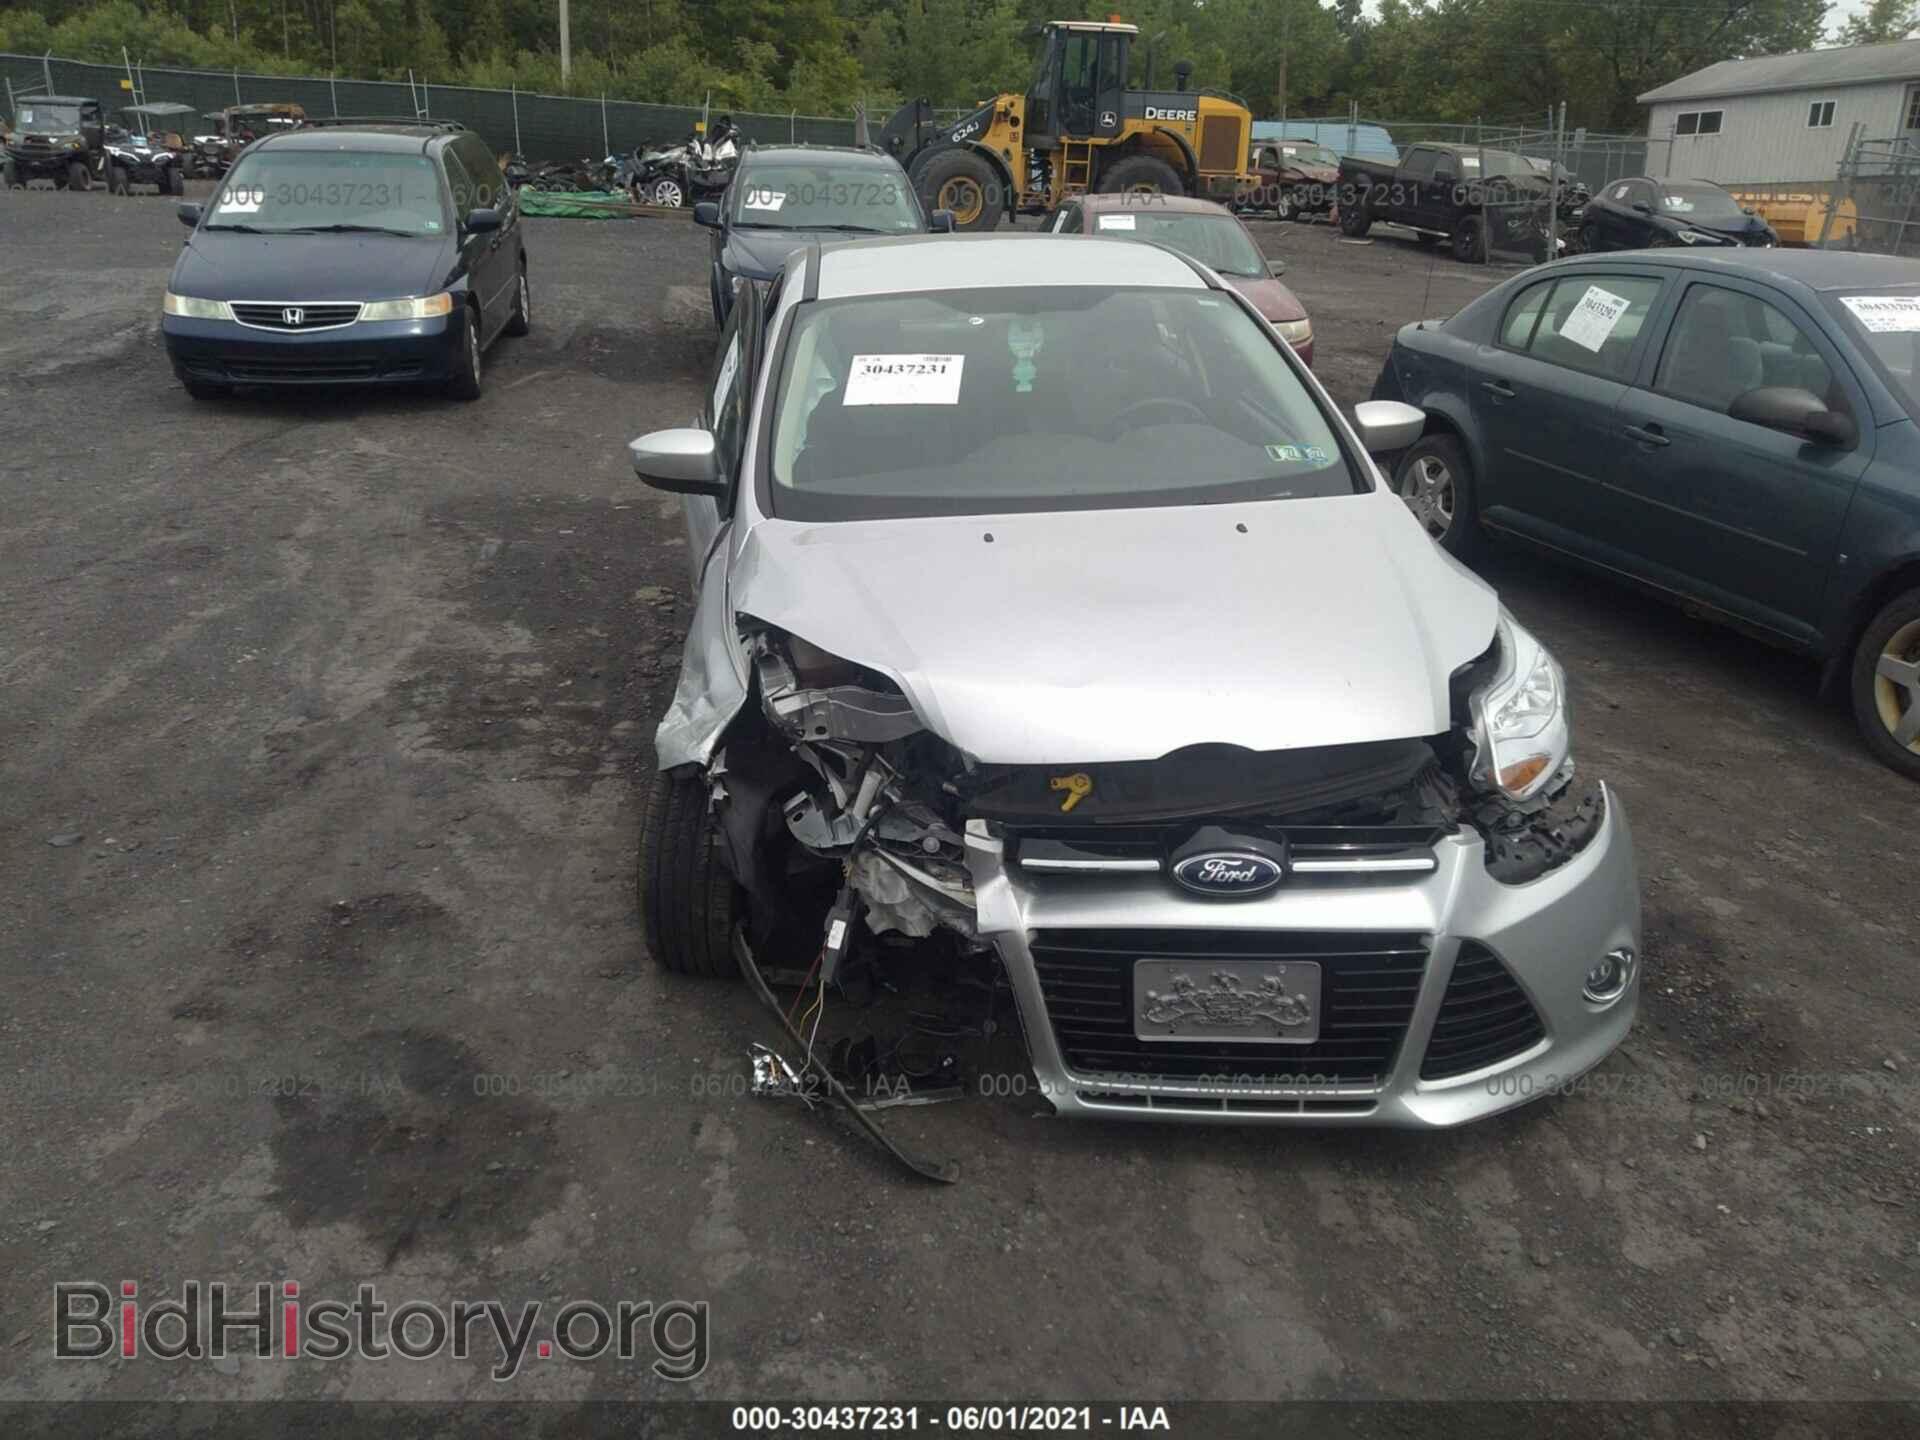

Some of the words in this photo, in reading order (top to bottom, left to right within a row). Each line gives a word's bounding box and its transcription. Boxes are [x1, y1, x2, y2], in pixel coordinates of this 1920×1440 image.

[1144, 106, 1197, 121] DEERE
[860, 363, 947, 376] 30437231
[1198, 859, 1257, 882] Ford
